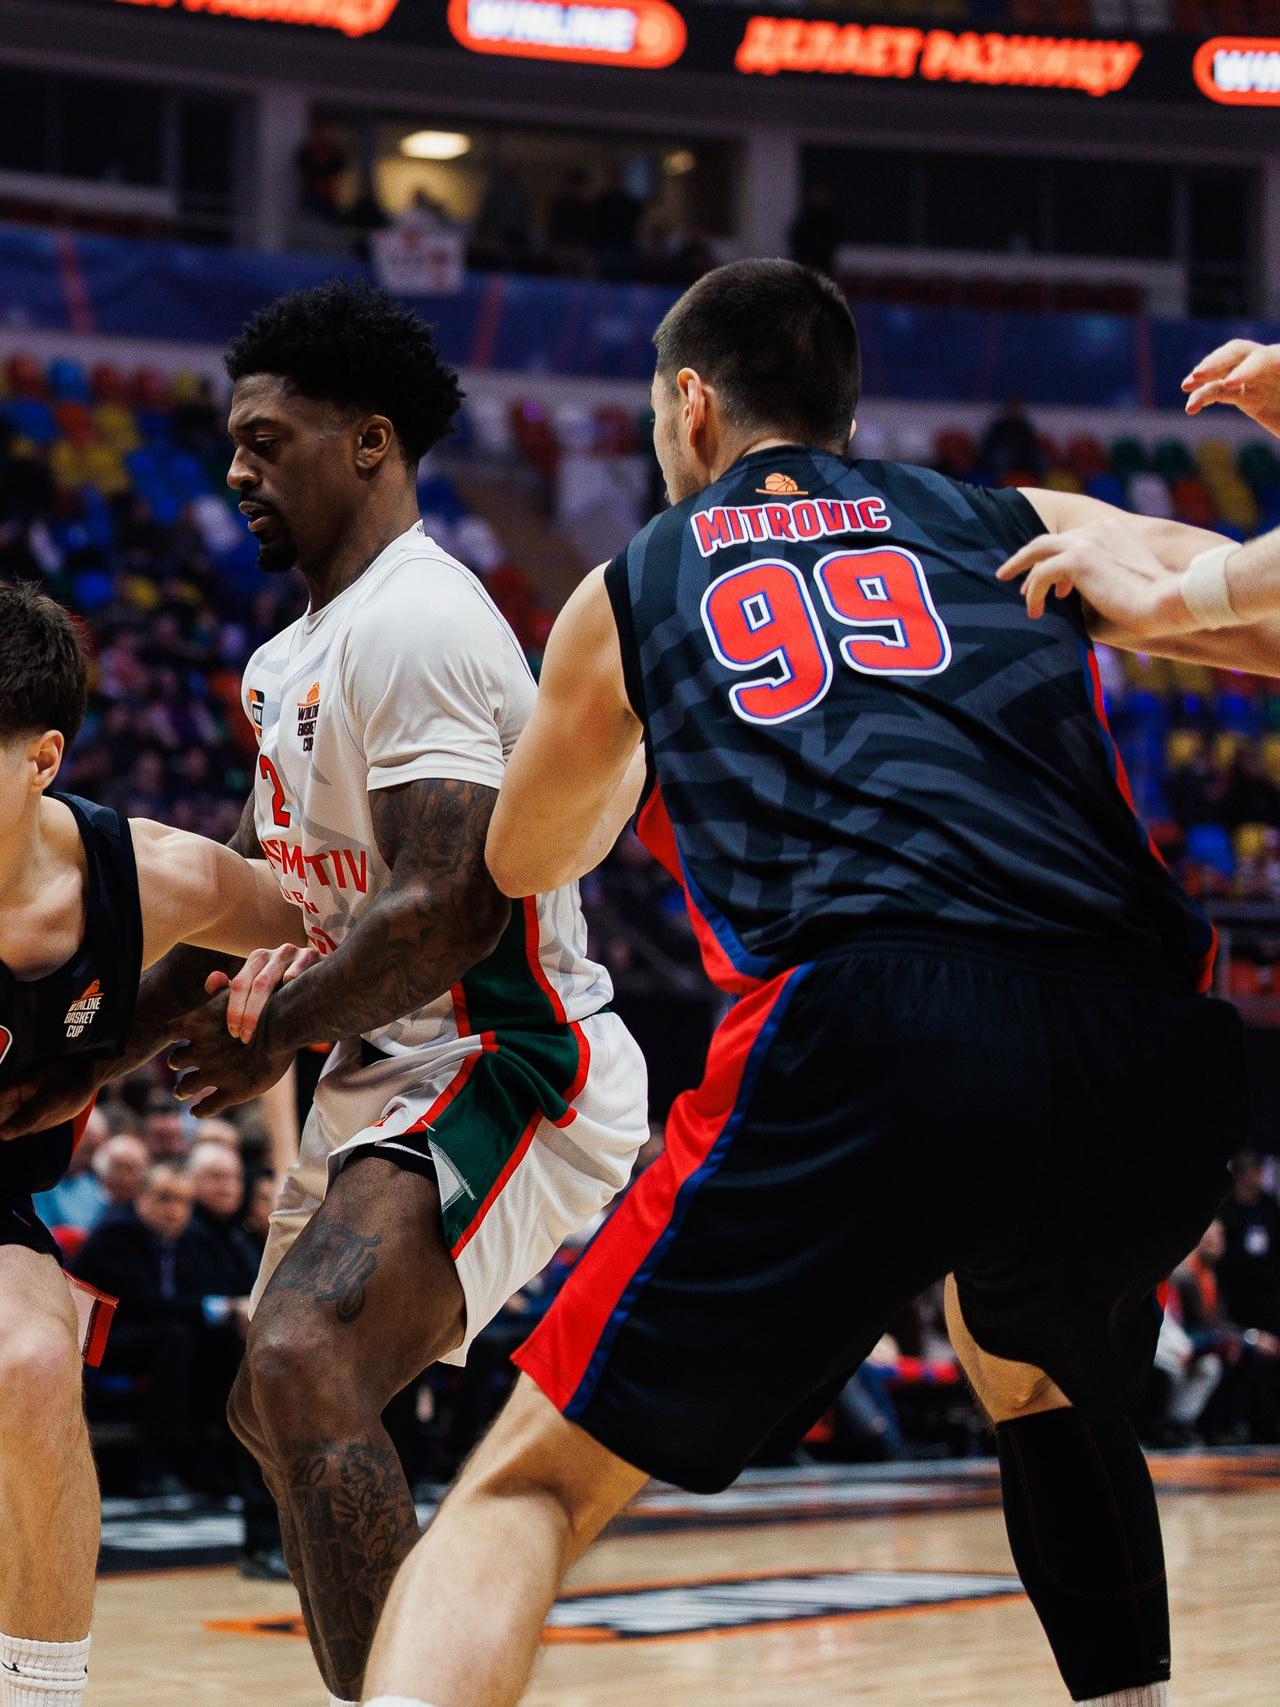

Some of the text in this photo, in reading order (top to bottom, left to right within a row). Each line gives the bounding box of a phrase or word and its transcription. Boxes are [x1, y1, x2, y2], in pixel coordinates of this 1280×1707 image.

[690, 496, 891, 558] MITROVIC
[700, 545, 952, 725] 99
[63, 1011, 96, 1024] BASKET
[66, 1024, 84, 1038] CUP
